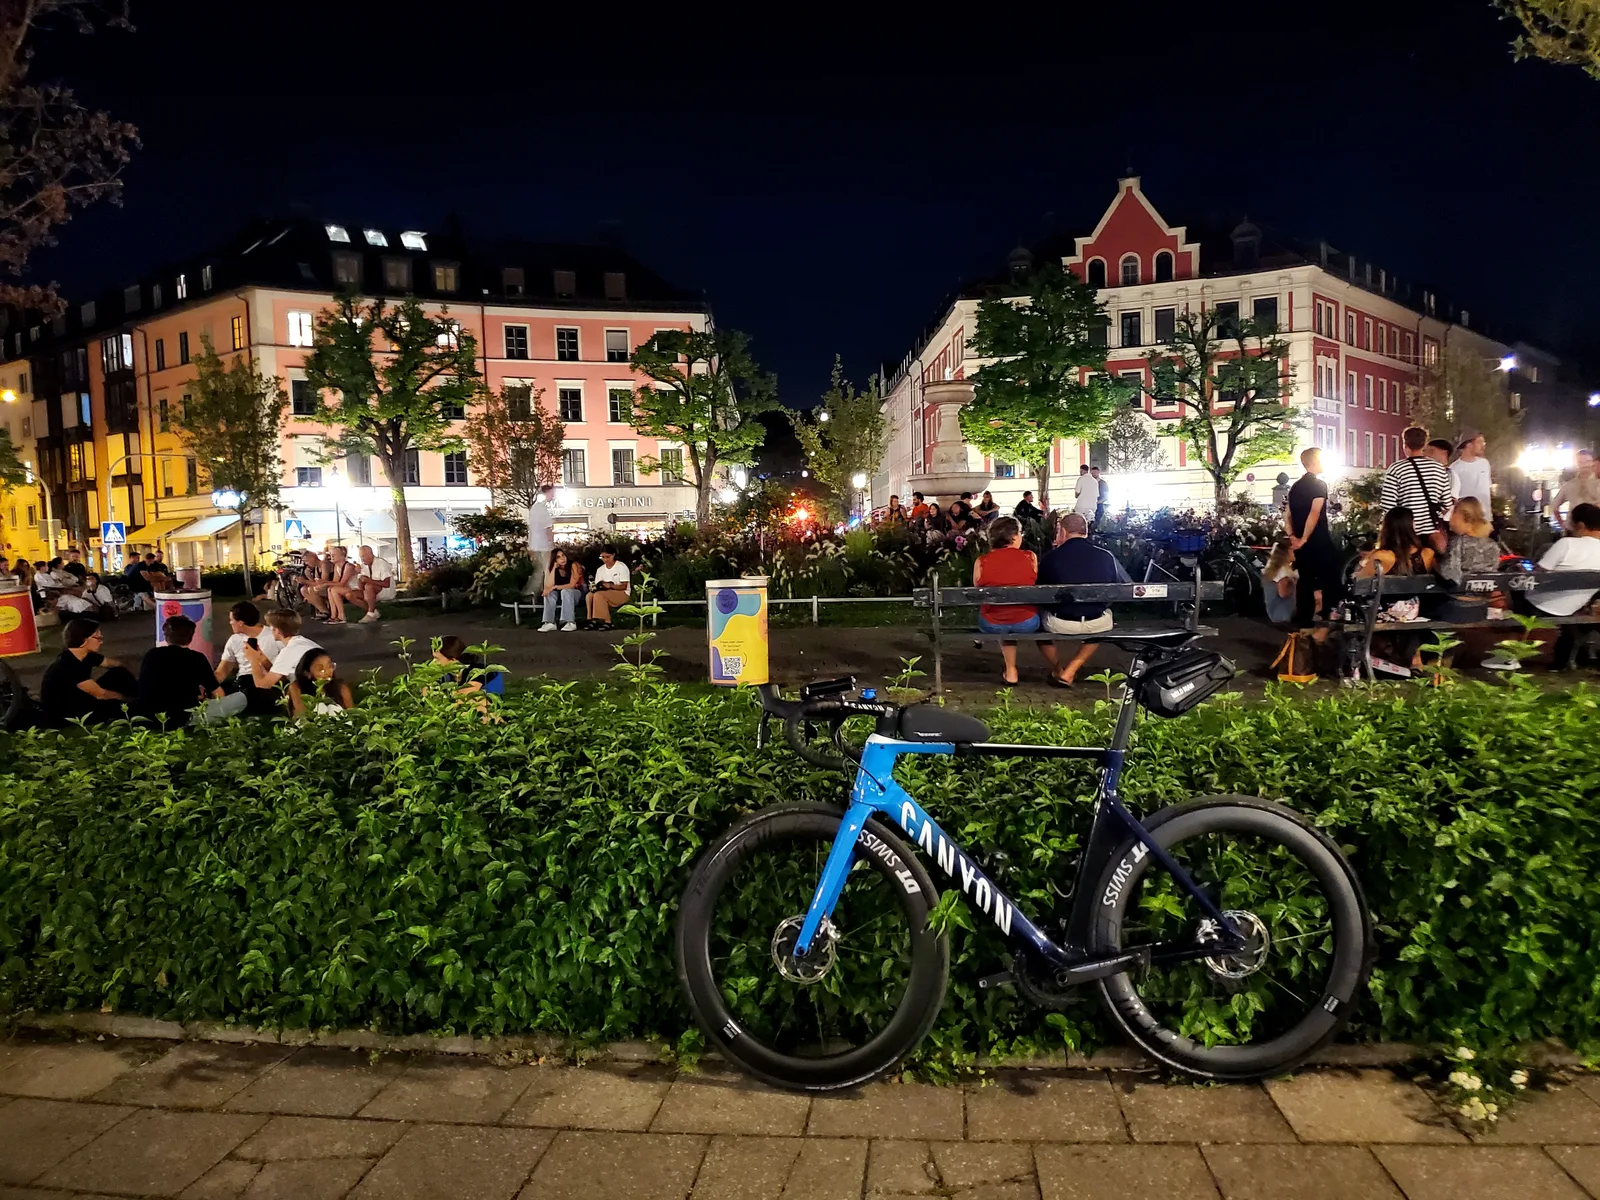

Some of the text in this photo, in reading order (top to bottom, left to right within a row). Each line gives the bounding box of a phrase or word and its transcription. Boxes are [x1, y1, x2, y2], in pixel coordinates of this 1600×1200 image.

[550, 496, 653, 509] MRGANTINI
[850, 702, 885, 712] CANYON
[856, 829, 922, 895] DT SWISS
[901, 801, 1013, 937] CANYON
[1102, 858, 1133, 908] SWISS
